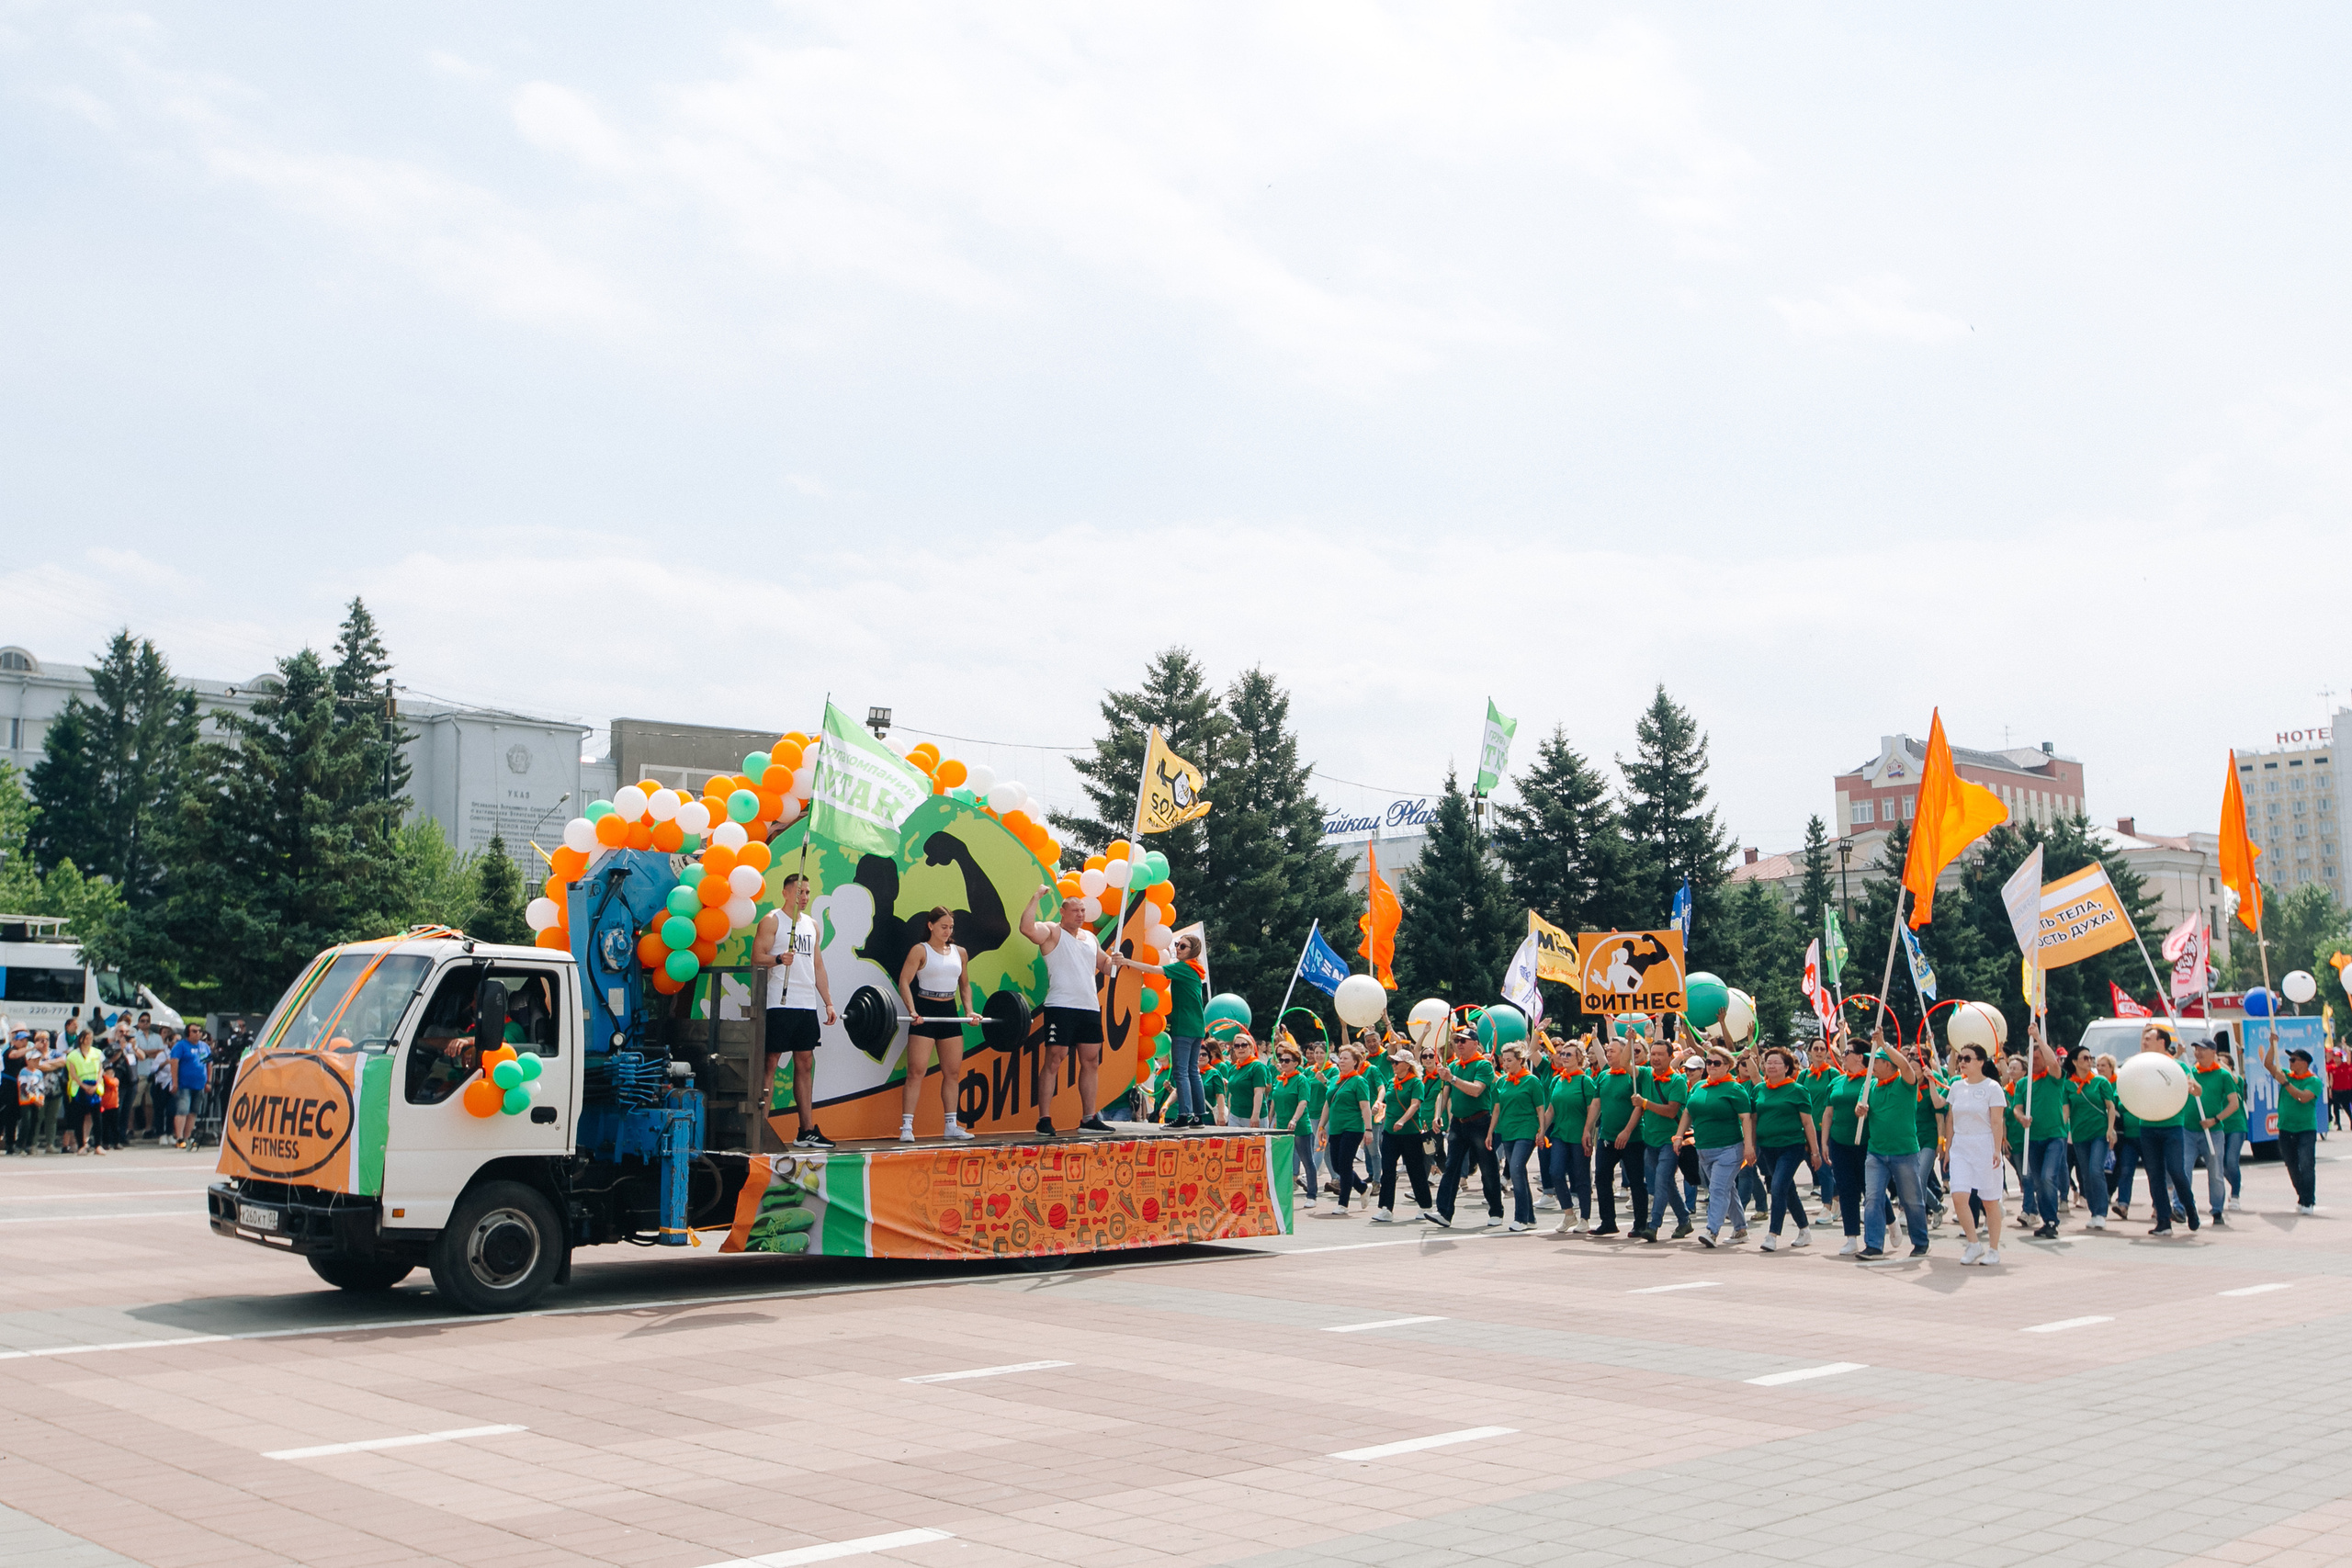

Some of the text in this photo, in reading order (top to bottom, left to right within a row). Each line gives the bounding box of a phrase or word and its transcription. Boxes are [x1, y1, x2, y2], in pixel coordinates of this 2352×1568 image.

[1323, 808, 1381, 834] айкал
[2056, 900, 2103, 922] ТЕЛА,
[2071, 910, 2116, 938] ДУХА!
[1308, 941, 1345, 983] AREN
[1585, 991, 1681, 1011] ФИТНЕС
[232, 1092, 338, 1140] ФИТНЕС
[251, 1135, 300, 1160] FITNESS
